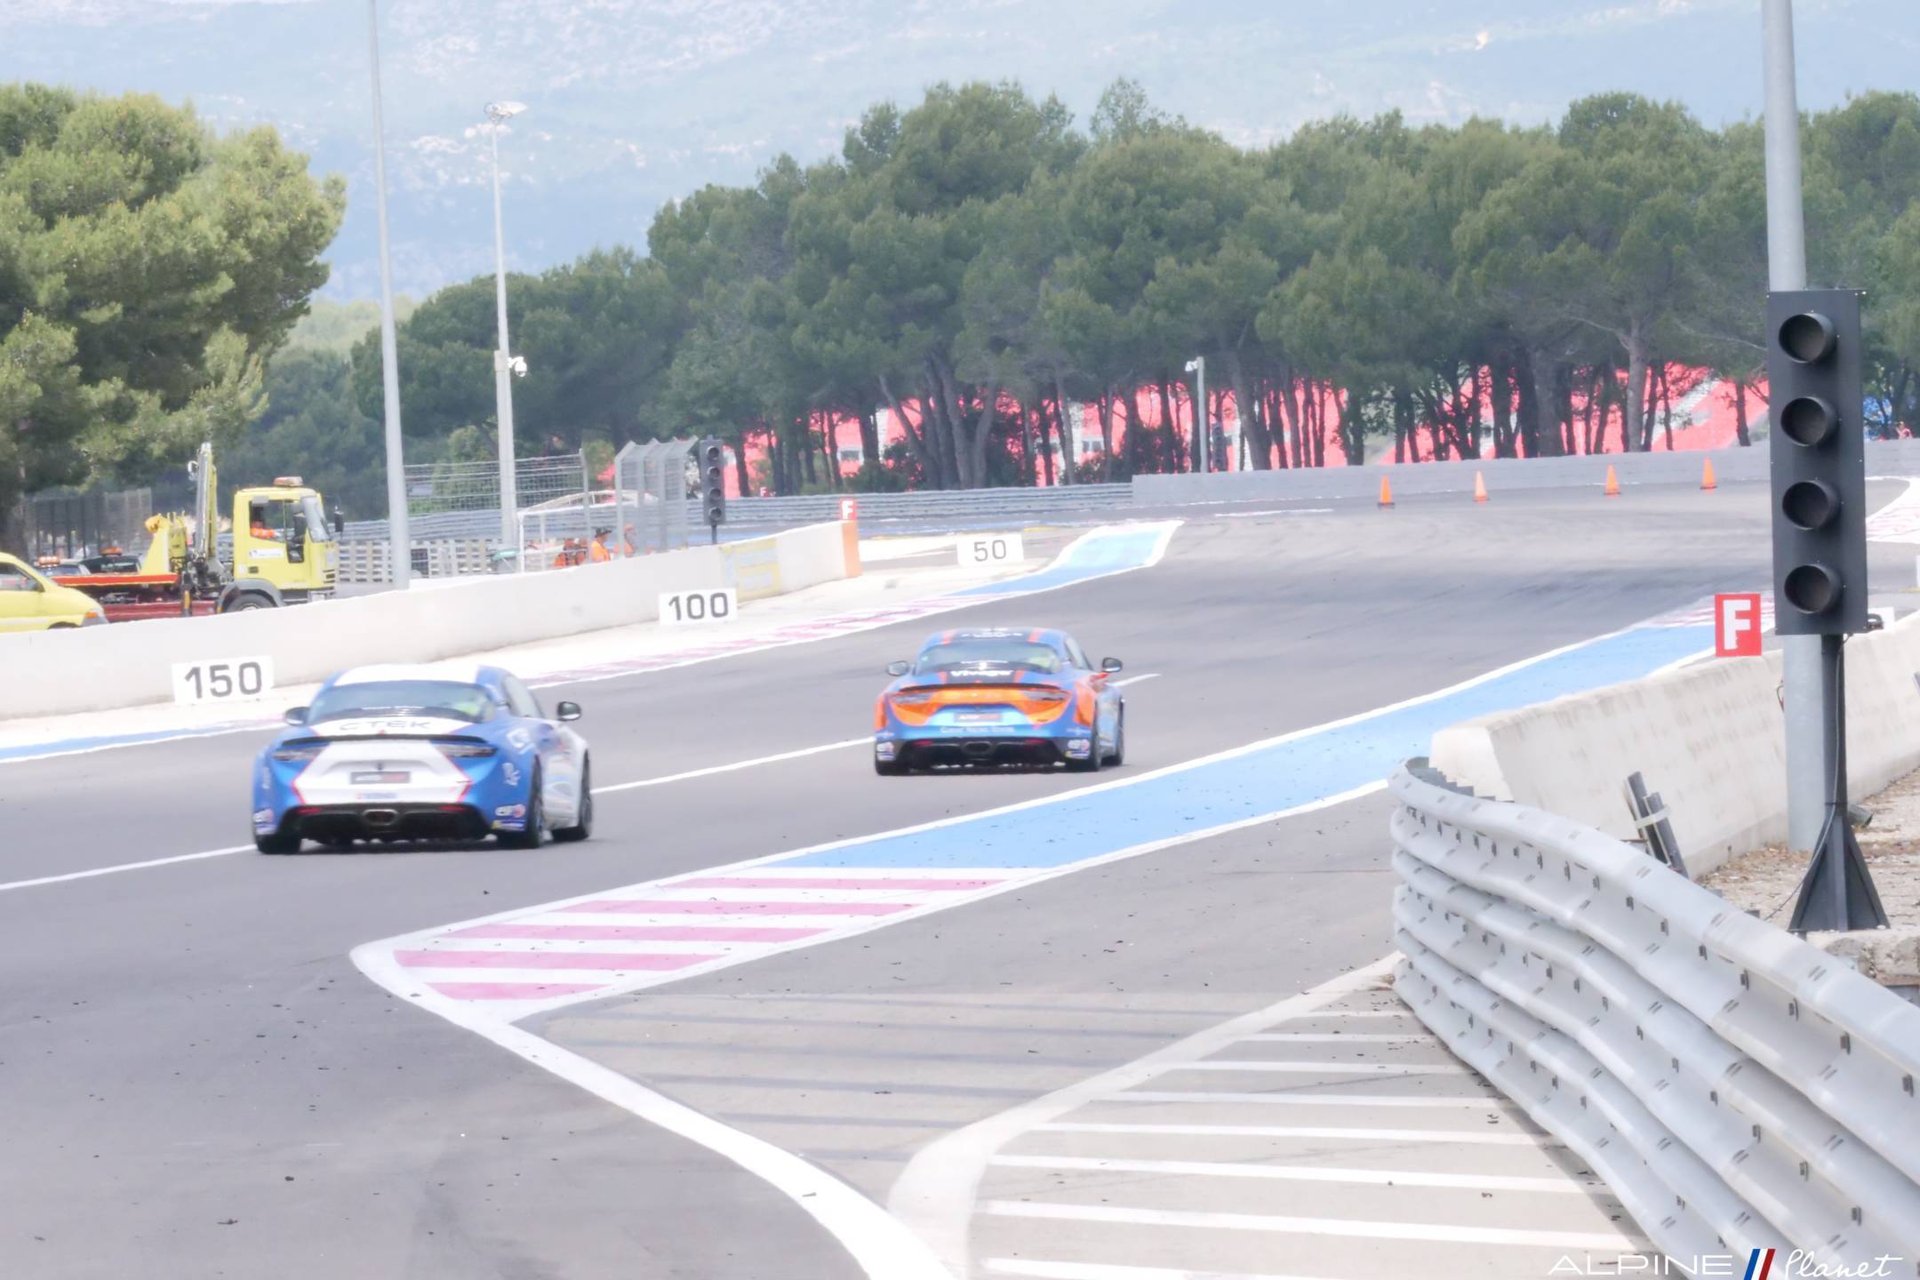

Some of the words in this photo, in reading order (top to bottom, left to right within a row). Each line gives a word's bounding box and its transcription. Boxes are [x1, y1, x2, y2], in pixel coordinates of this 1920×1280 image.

[841, 500, 854, 519] F
[973, 539, 1007, 562] 50
[668, 592, 729, 621] 100
[1723, 599, 1751, 650] F
[184, 661, 262, 699] 150
